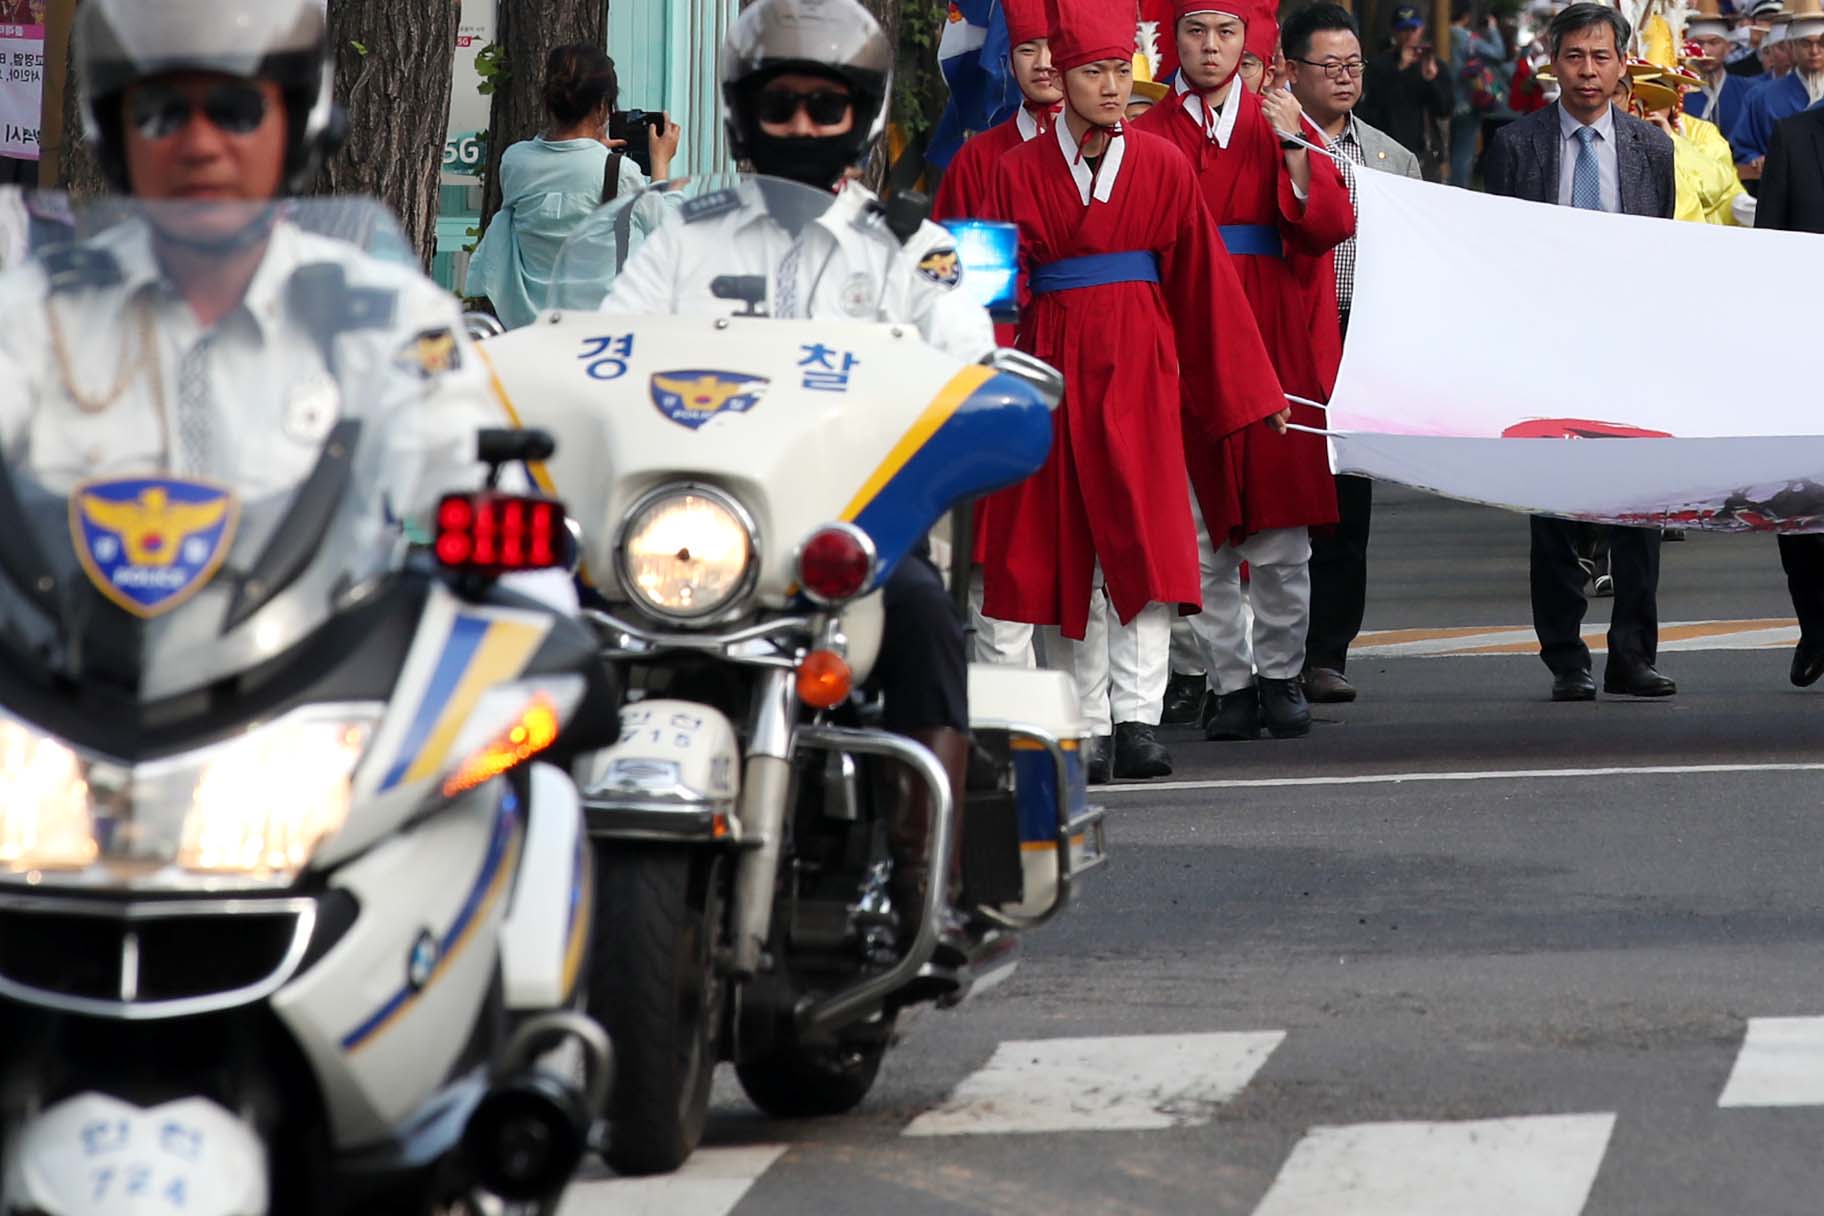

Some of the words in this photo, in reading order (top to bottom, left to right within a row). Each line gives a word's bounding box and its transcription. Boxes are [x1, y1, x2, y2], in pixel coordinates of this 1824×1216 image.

[443, 136, 480, 165] 5G
[577, 333, 635, 381] 경
[796, 342, 861, 392] 찰
